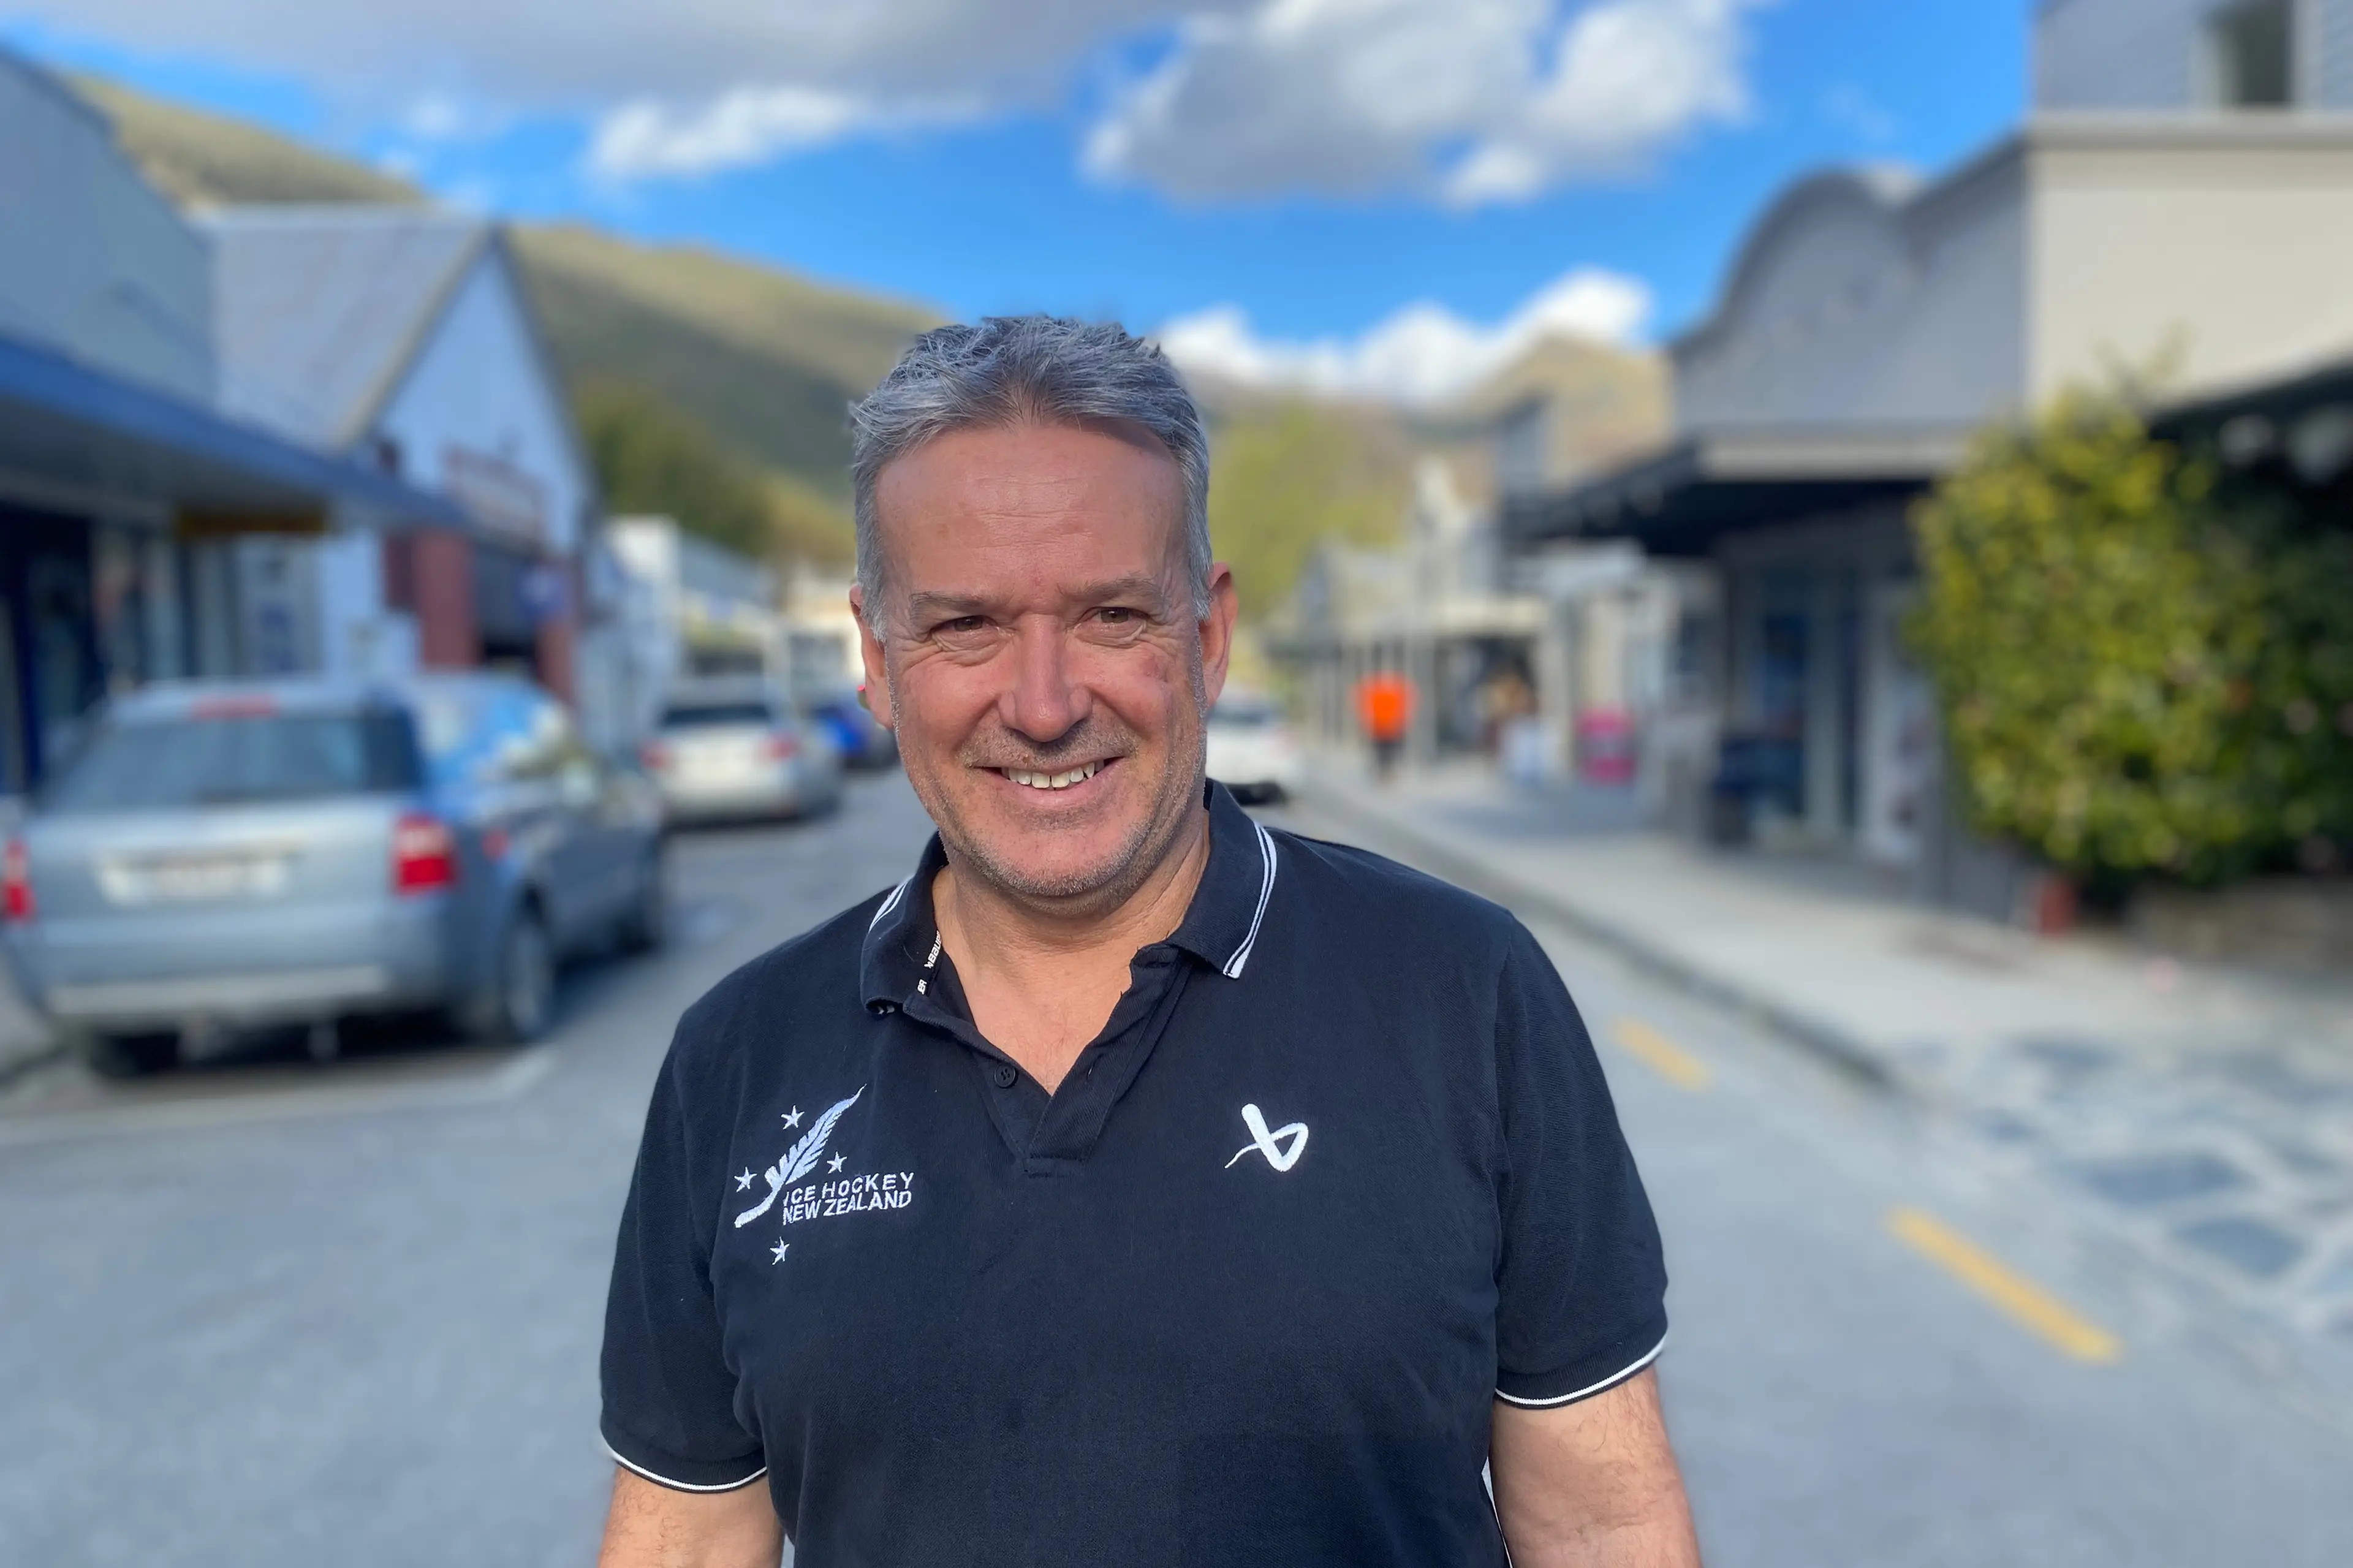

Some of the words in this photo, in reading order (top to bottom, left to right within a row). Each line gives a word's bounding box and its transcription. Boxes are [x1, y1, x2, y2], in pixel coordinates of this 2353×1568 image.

[782, 1184, 816, 1207] ICE
[822, 1172, 914, 1199] HOCKEY
[782, 1200, 822, 1226] NEW
[823, 1190, 912, 1216] ZEALAND
